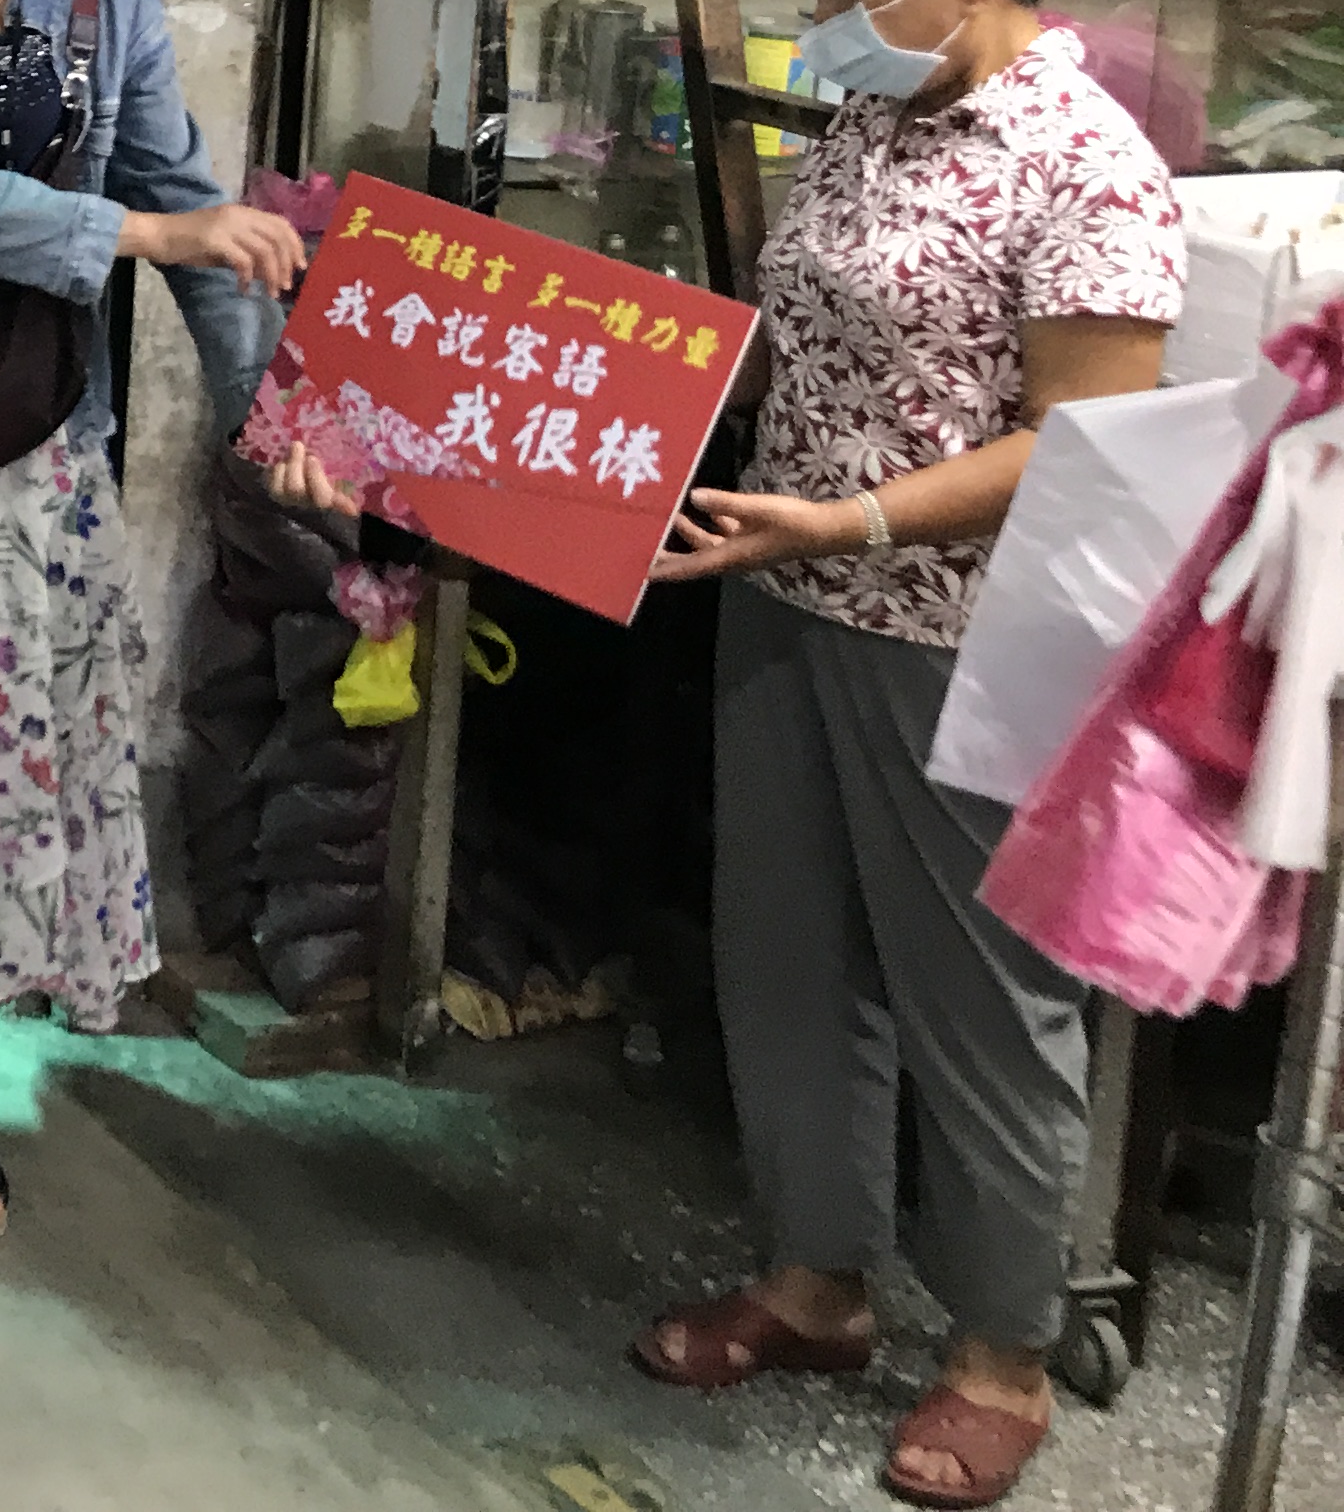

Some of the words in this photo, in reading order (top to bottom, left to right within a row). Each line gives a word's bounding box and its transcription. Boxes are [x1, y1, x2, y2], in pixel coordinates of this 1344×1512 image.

[337, 205, 516, 294] 多一種語言
[526, 273, 721, 370] 多一種力量
[435, 382, 663, 499] 我很棒
